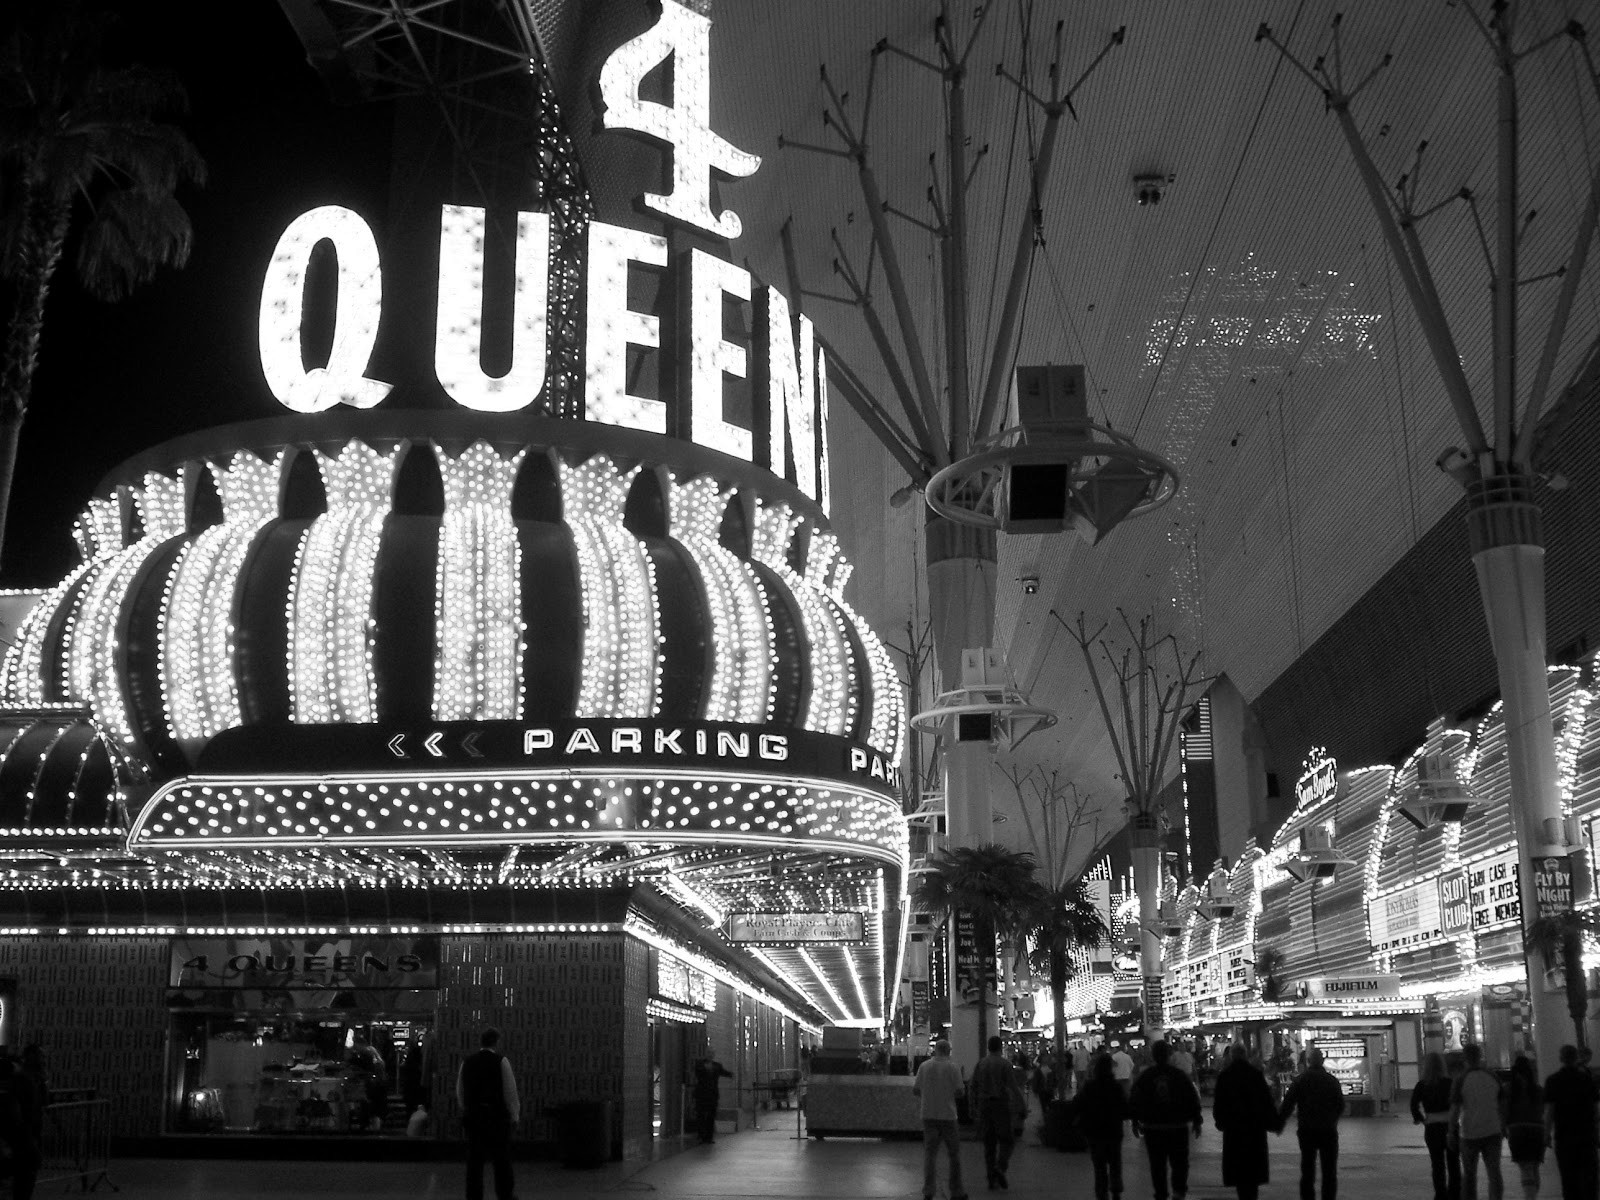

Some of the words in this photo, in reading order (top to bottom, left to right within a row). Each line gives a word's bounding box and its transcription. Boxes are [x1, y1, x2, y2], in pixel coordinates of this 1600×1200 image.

[600, 0, 762, 239] 4
[258, 204, 829, 519] QUEEN
[524, 727, 788, 760] PARKING
[1489, 862, 1507, 882] CASH
[1535, 871, 1553, 887] FLY
[1555, 871, 1571, 887] BY
[1443, 876, 1467, 903] SLOT
[1537, 887, 1571, 902] NIGHT
[1445, 903, 1468, 929] CLUB
[1474, 908, 1490, 927] FREE
[183, 955, 208, 971] 4
[228, 954, 422, 974] QUEENS
[1325, 980, 1378, 992] FUJIFILM
